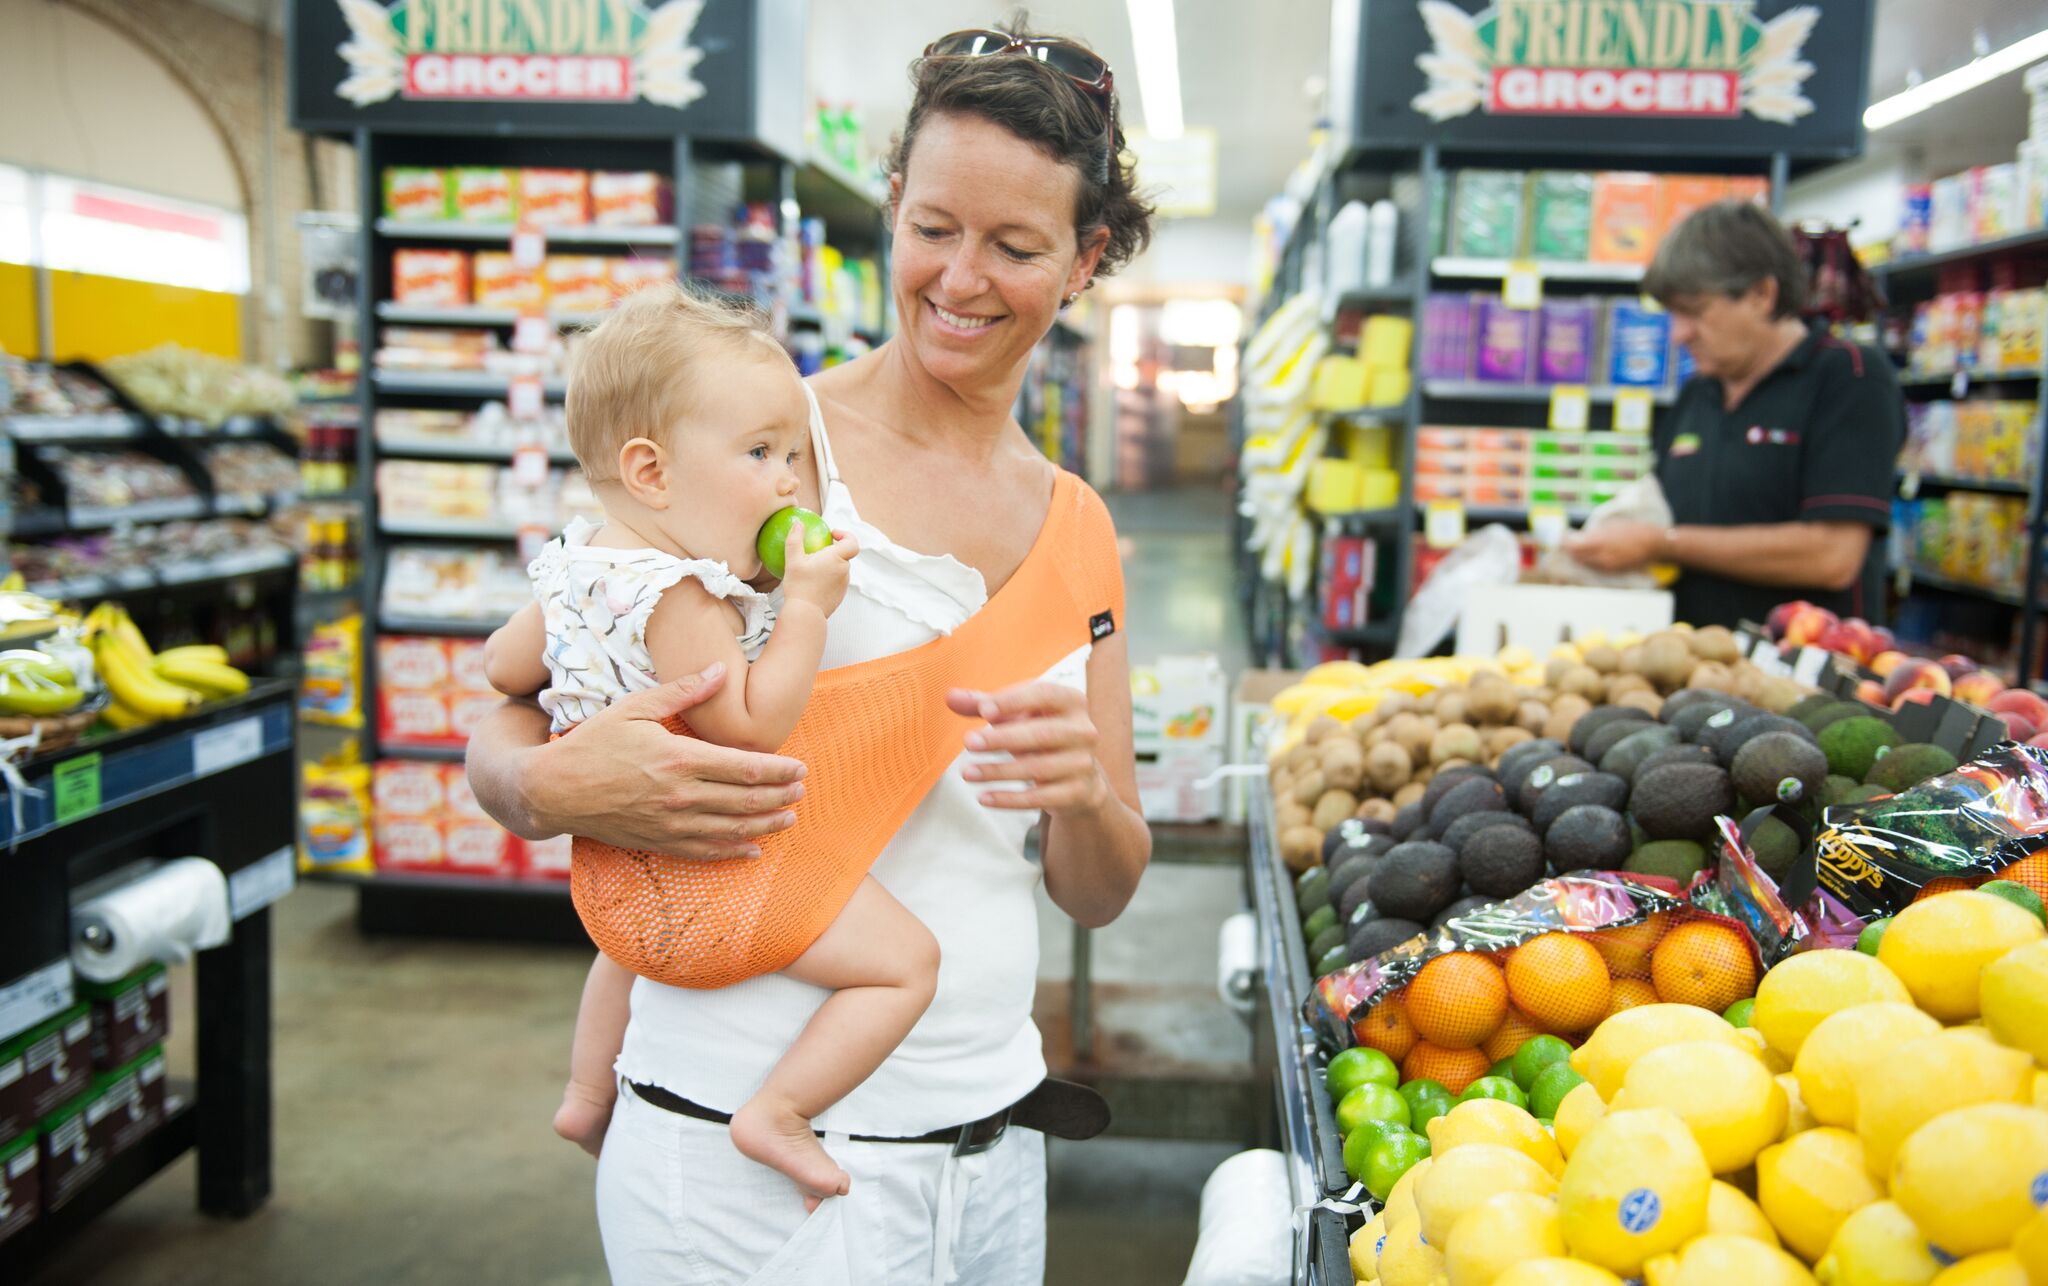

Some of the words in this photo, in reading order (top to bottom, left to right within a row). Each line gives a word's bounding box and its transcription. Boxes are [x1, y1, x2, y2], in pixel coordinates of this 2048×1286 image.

[405, 0, 633, 53] FRIENDLY
[1496, 0, 1742, 66] FRIENDLY
[413, 57, 621, 96] GROCER
[1499, 70, 1728, 111] GROCER
